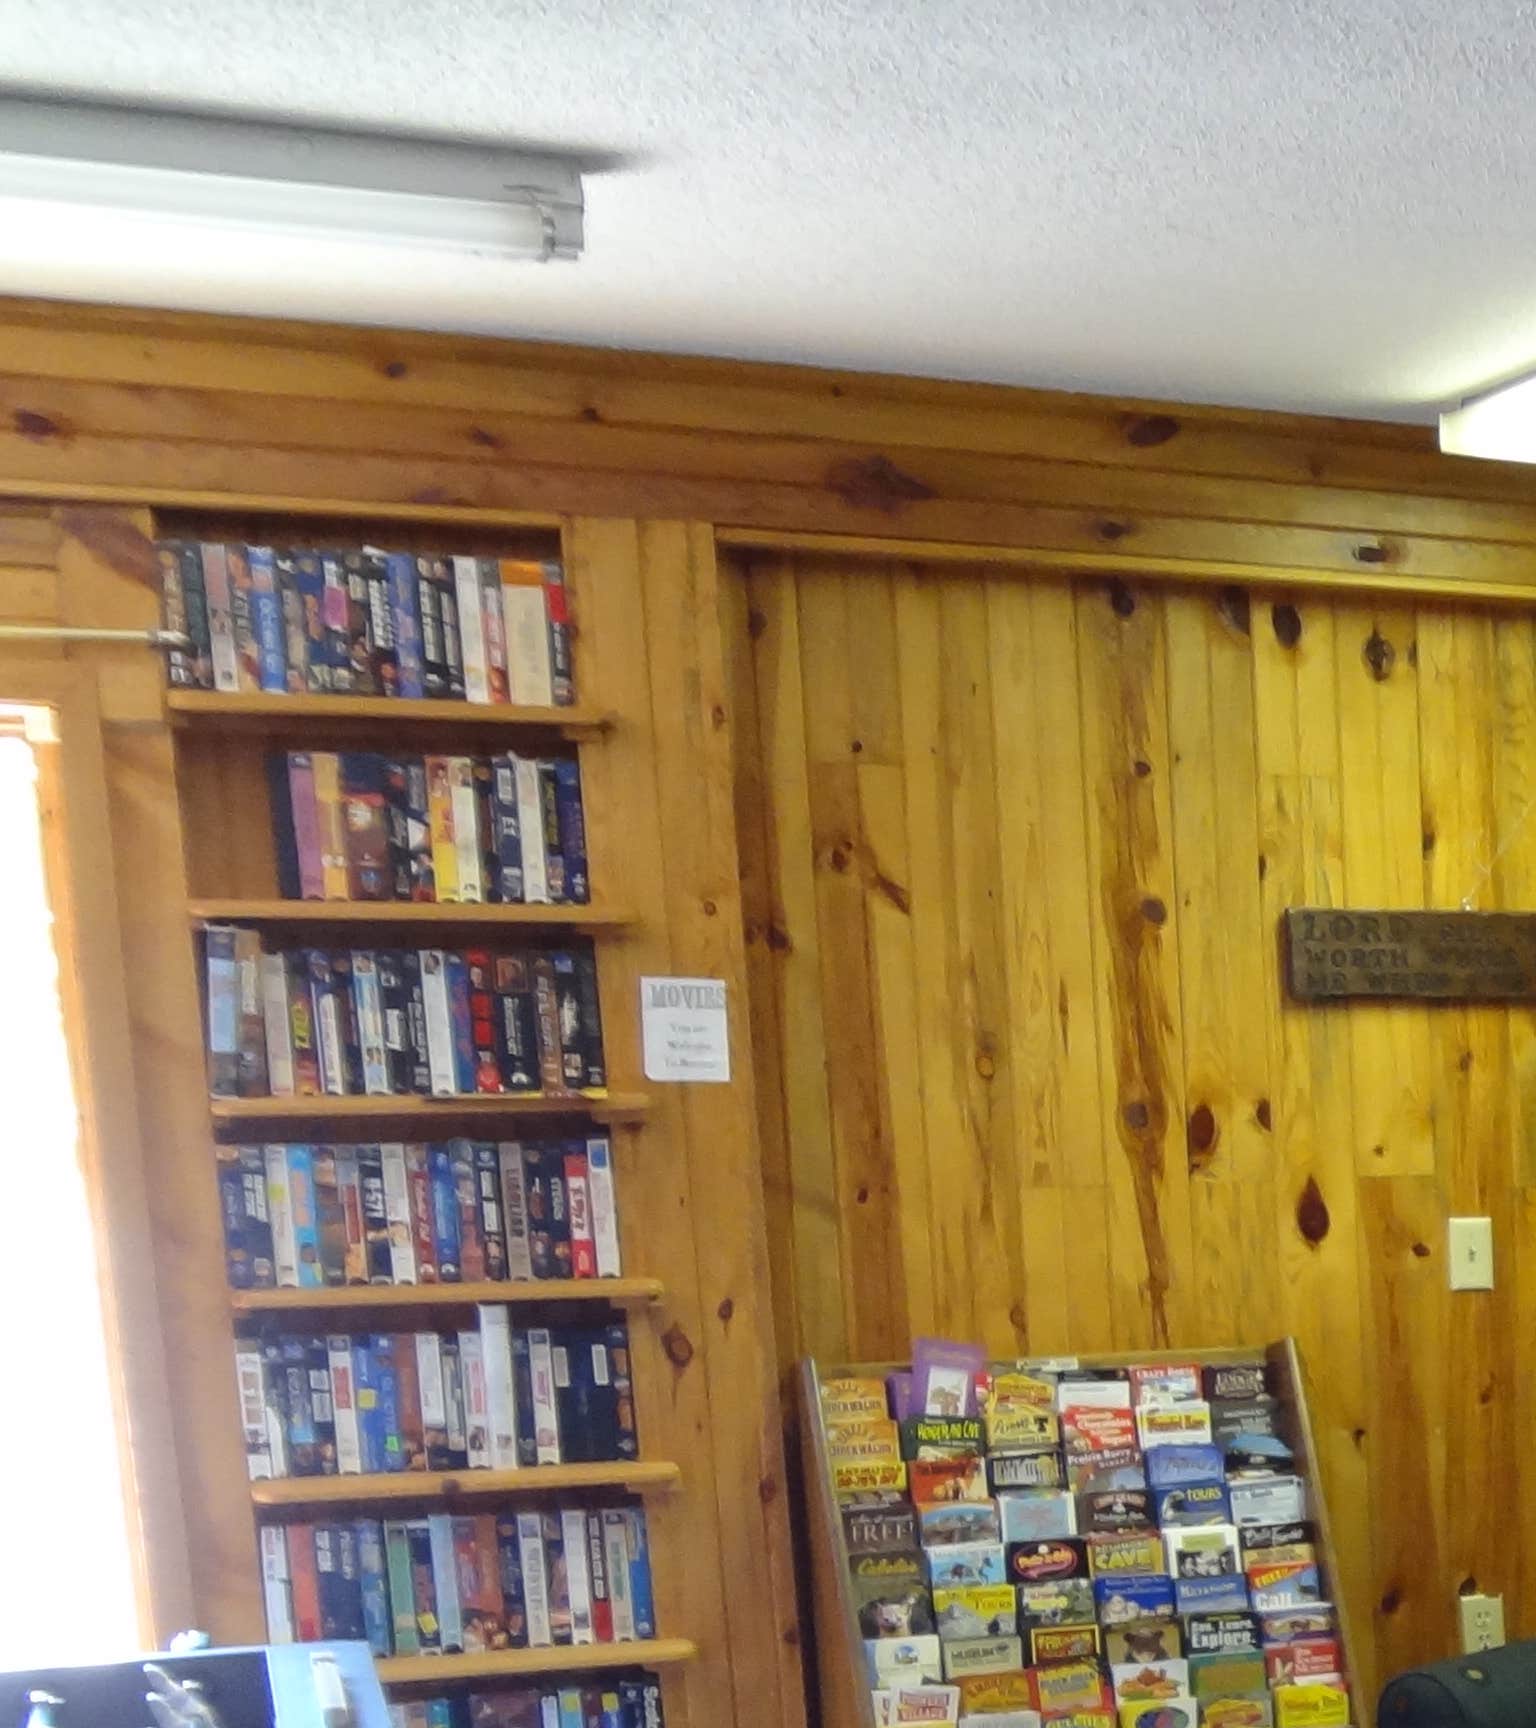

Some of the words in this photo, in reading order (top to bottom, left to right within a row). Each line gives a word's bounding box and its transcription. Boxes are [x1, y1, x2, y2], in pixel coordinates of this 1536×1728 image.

[1303, 913, 1413, 943] LORD
[1187, 1487, 1222, 1502] TOURS
[1191, 1630, 1256, 1649] Explore.
